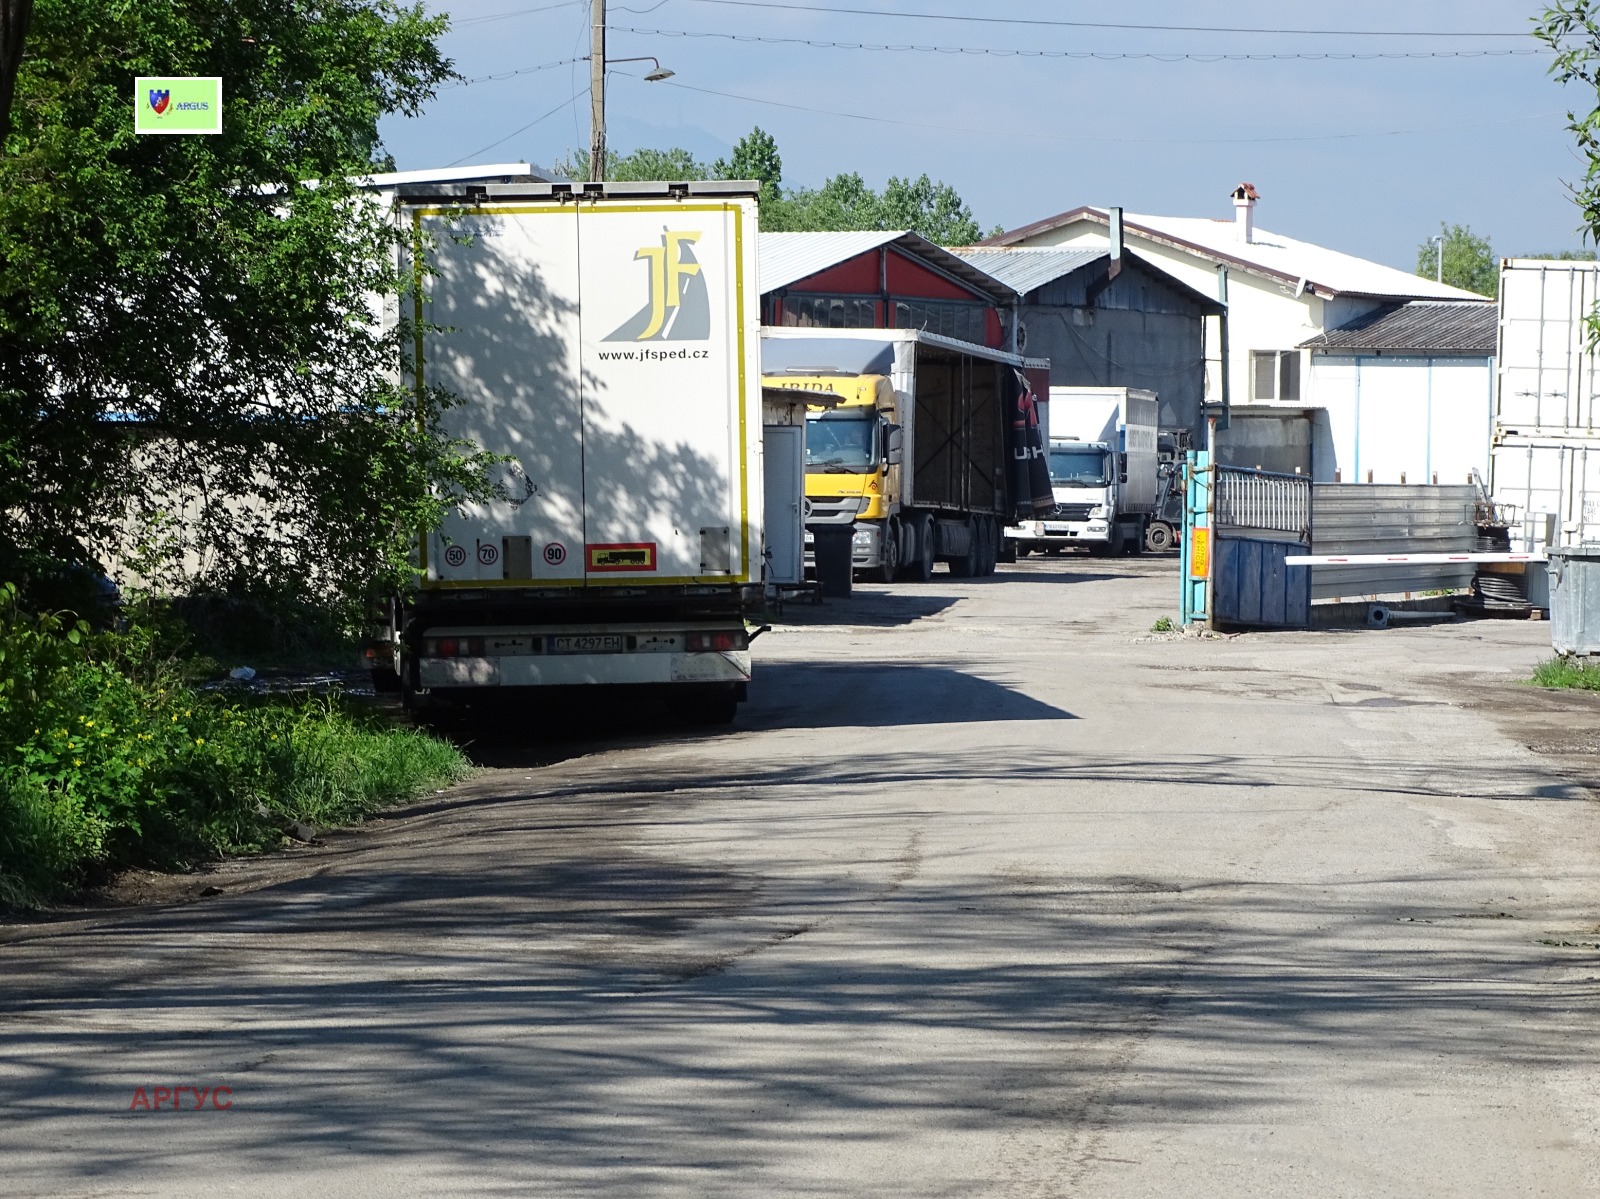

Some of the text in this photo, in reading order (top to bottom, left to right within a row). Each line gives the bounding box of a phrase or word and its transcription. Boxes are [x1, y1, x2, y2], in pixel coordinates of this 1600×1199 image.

[598, 348, 709, 361] www.jfsped.cz
[449, 551, 462, 561] 50
[482, 549, 495, 559] 70
[548, 548, 561, 560] 90
[556, 637, 620, 650] CT 4297 EH
